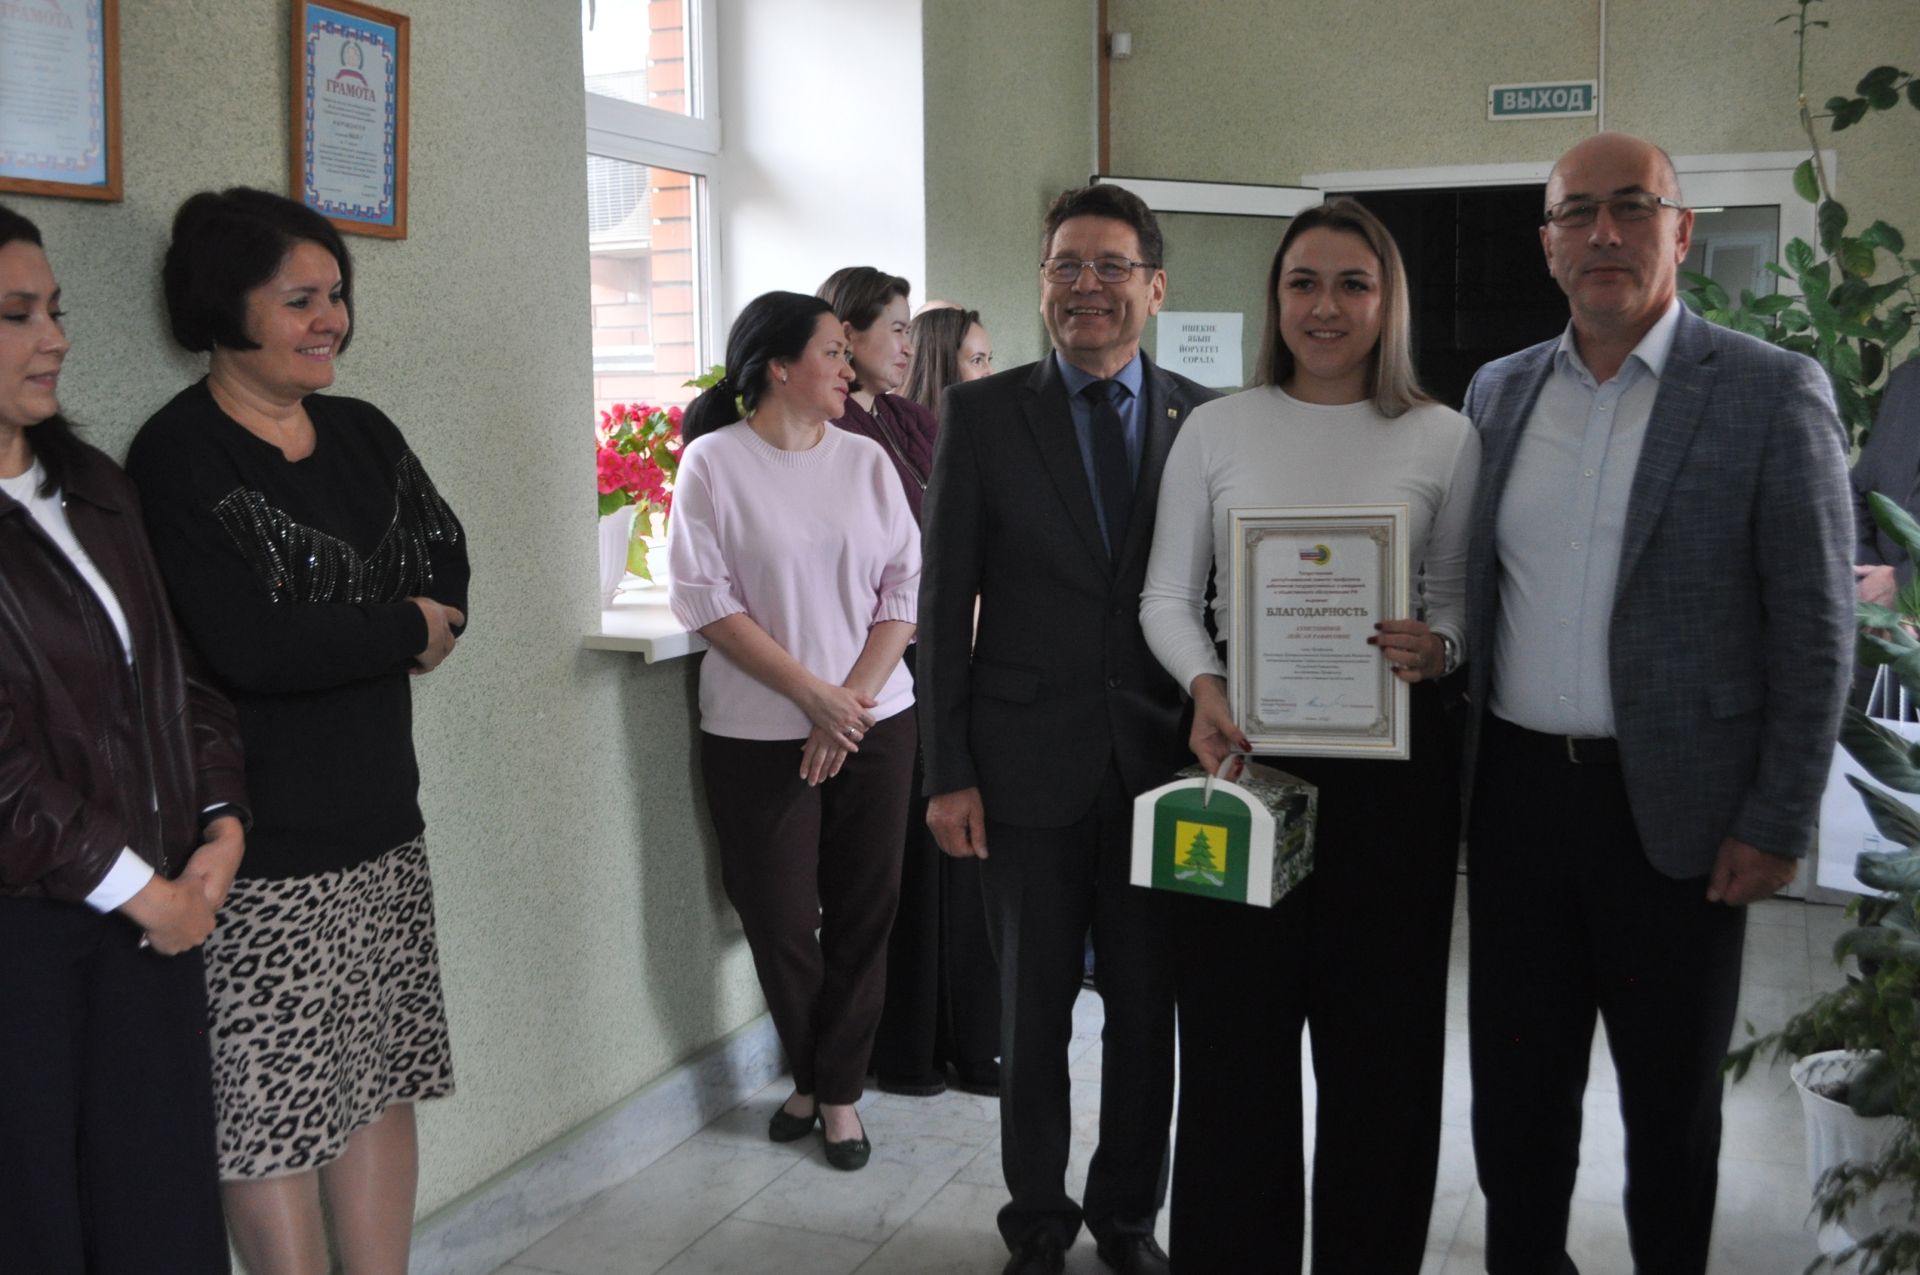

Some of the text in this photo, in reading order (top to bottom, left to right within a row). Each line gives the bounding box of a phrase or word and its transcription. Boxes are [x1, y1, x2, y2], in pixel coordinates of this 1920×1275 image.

[326, 79, 376, 102] ГРАМОТА
[1503, 88, 1585, 111] ВЫХОД
[1266, 607, 1368, 618] БЛАГОДАРНОСТЬ
